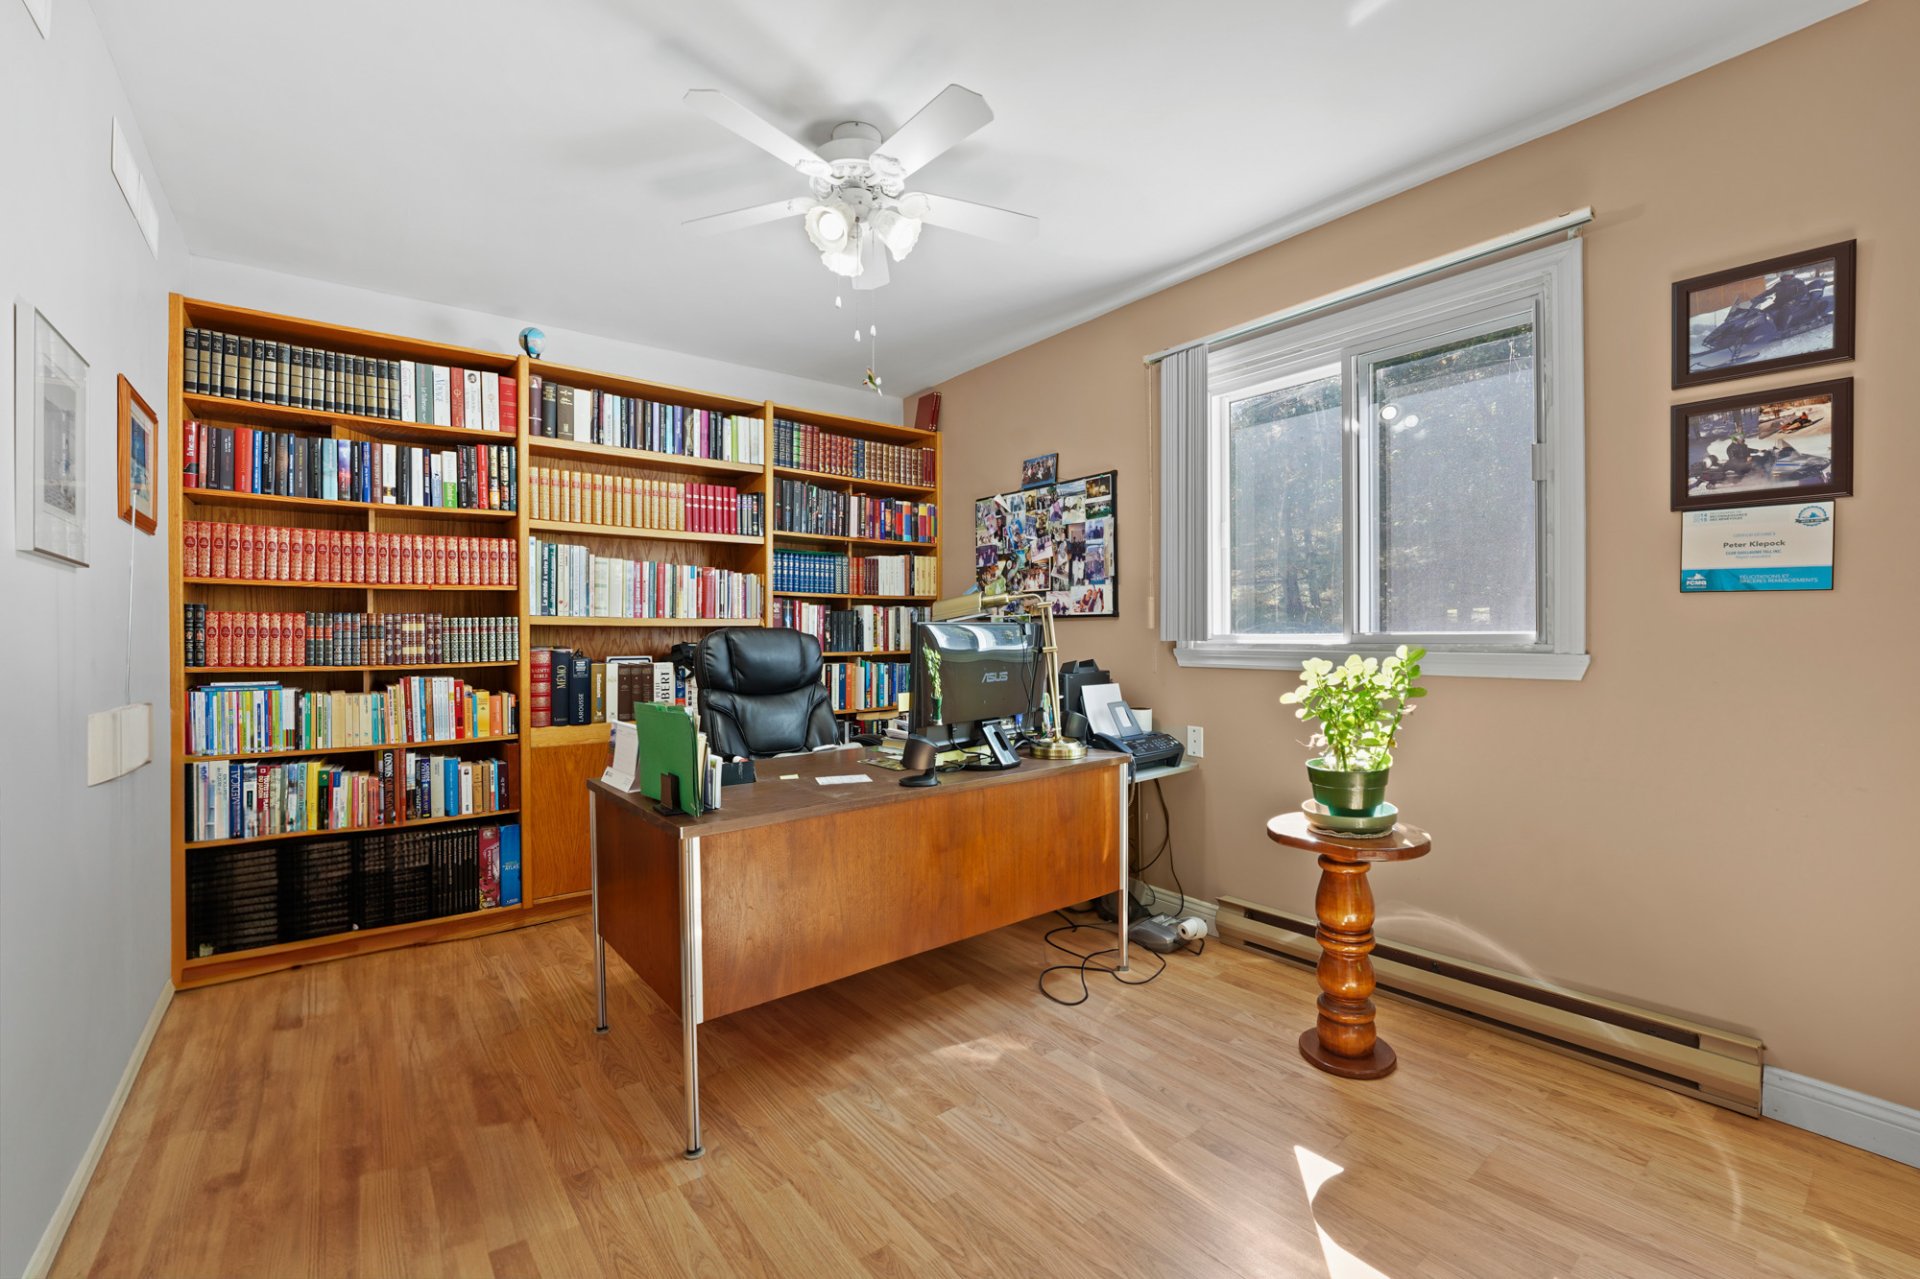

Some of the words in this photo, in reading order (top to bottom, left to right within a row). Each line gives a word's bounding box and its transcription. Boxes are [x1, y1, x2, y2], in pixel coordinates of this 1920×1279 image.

[556, 665, 567, 689] MÉMO
[660, 671, 670, 703] BERT
[981, 671, 1009, 684] ASUS
